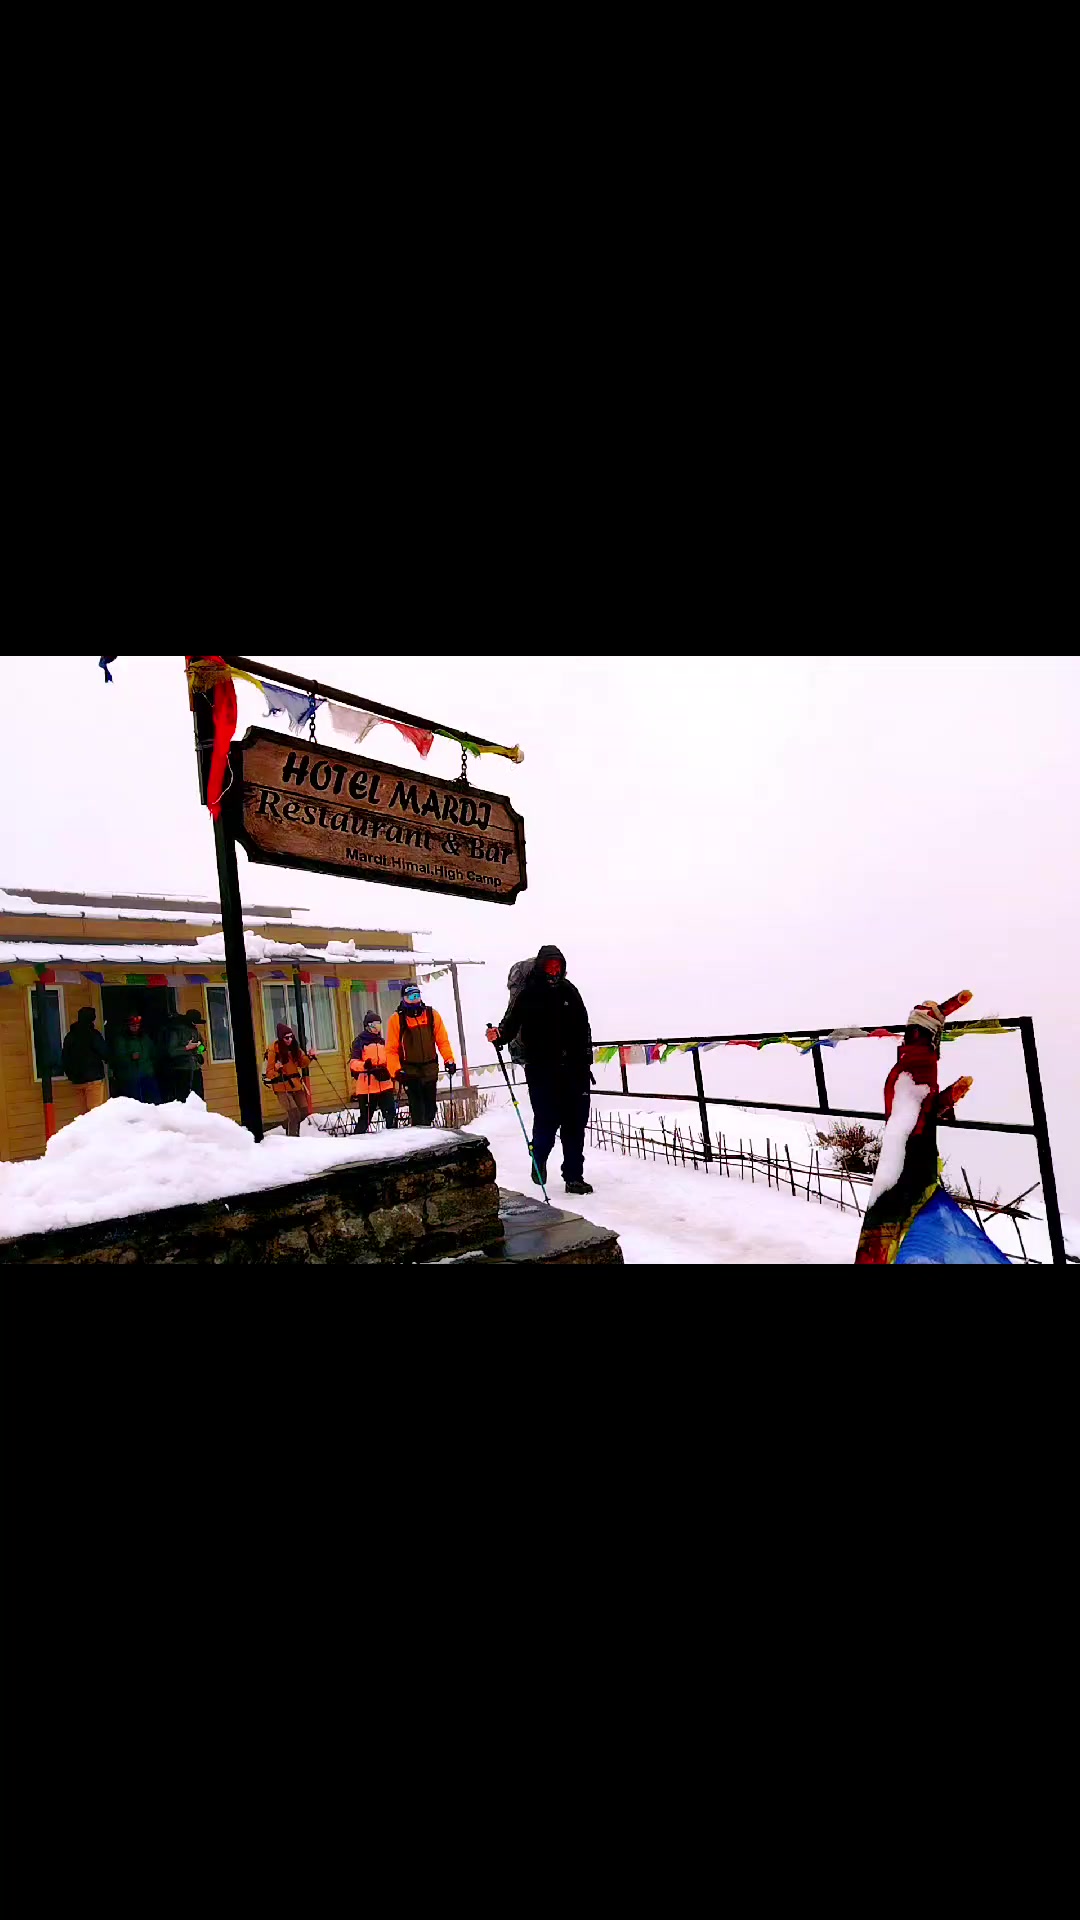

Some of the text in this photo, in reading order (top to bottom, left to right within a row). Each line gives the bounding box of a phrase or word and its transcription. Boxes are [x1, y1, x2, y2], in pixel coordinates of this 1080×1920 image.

[282, 751, 380, 804] HOTEL
[255, 789, 513, 865] Restaurant & Bar
[345, 848, 387, 866] Mardi
[466, 871, 502, 887] Camp
